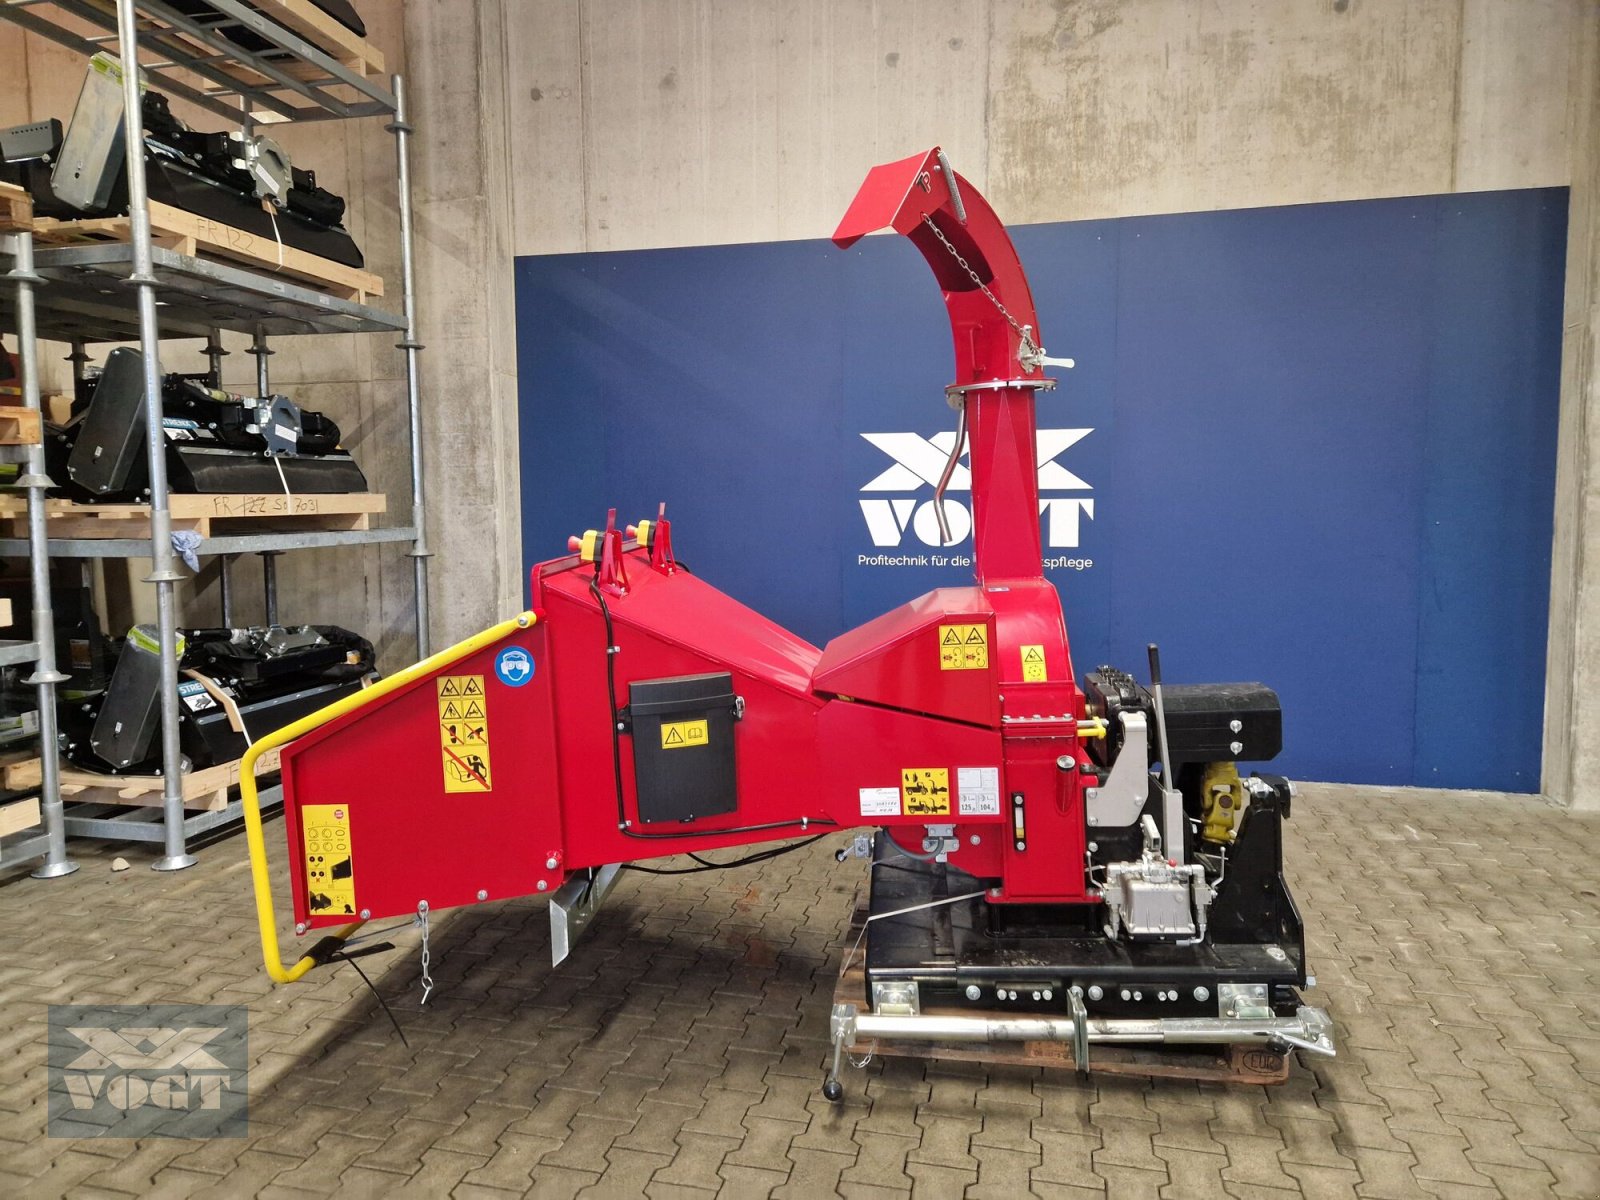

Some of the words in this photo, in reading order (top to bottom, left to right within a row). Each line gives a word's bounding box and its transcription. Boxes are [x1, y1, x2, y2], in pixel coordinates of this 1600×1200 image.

[197, 219, 218, 243] FR
[226, 227, 256, 255] 122
[213, 496, 232, 515] FR
[859, 498, 1094, 547] VOT
[858, 554, 928, 567] Profitechnik
[931, 554, 948, 567] für
[951, 554, 970, 567] die
[179, 682, 204, 694] STRE
[1251, 1054, 1274, 1070] EUR
